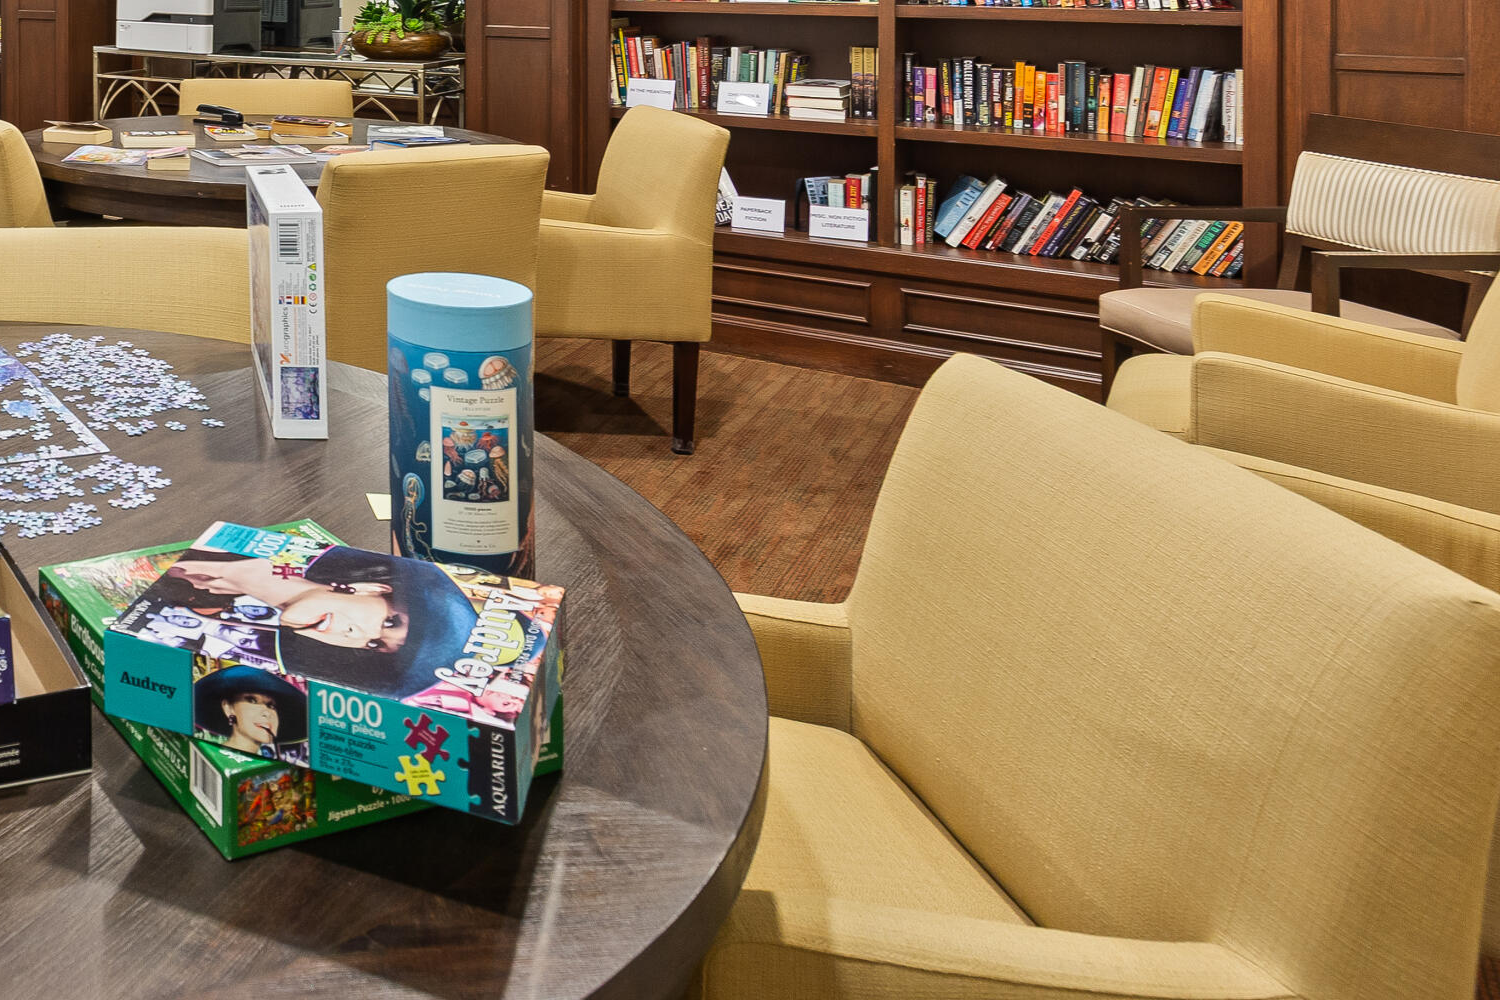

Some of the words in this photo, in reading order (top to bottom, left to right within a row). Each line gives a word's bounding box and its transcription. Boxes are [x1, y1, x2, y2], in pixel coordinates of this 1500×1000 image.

[964, 60, 973, 85] COLLEEN
[700, 75, 708, 97] WOMEN
[964, 86, 973, 109] HOOVER
[821, 222, 855, 230] LITERATURE
[447, 394, 478, 405] Vintage
[480, 396, 505, 404] Puzzle
[70, 614, 105, 666] Birdhous
[434, 590, 535, 697] Audrey
[523, 635, 537, 651] DAYS
[120, 671, 177, 699] Audrey
[316, 688, 383, 728] 1000
[318, 715, 346, 731] piece
[351, 721, 387, 740] pièces
[490, 732, 506, 817] AQUARIUS
[328, 807, 357, 822] Jigsaw
[357, 800, 385, 815] Puzzle
